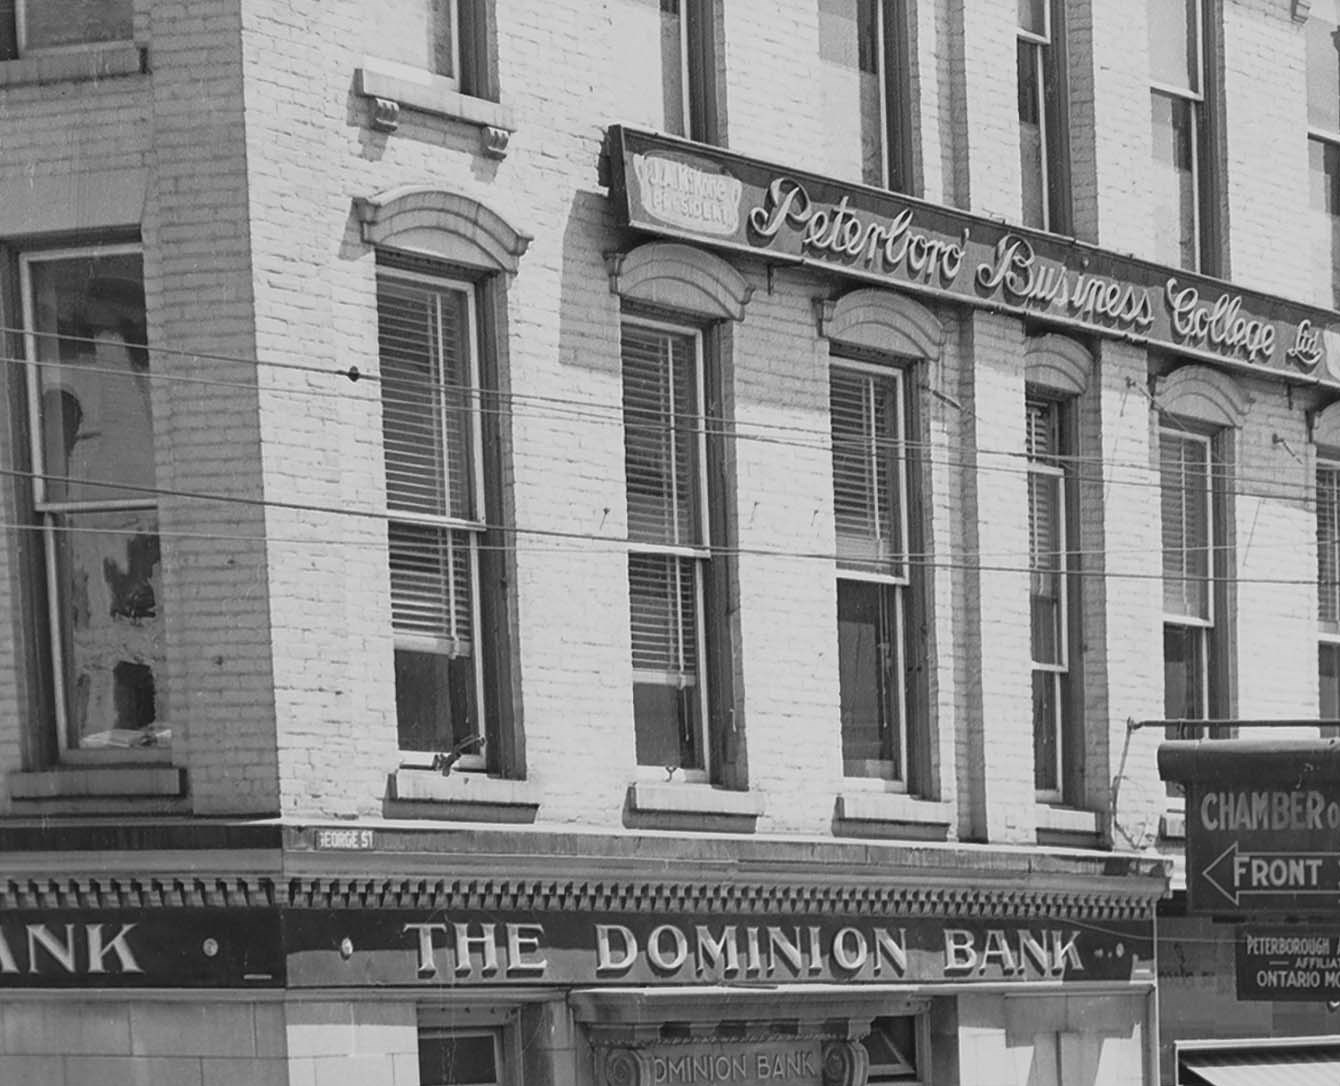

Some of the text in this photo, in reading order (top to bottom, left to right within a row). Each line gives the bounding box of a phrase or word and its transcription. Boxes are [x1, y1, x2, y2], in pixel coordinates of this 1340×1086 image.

[975, 233, 1155, 325] Business
[1166, 277, 1277, 363] College
[1201, 790, 1324, 831] CHAMBER
[320, 831, 374, 848] GEORGE ST
[1233, 858, 1323, 888] FRONT
[403, 923, 1085, 979] THE DOMINION BANK
[1247, 935, 1331, 957] PETERBOROUGH
[1255, 969, 1320, 989] ONTARIO
[654, 1052, 819, 1083] OMINION BANK
